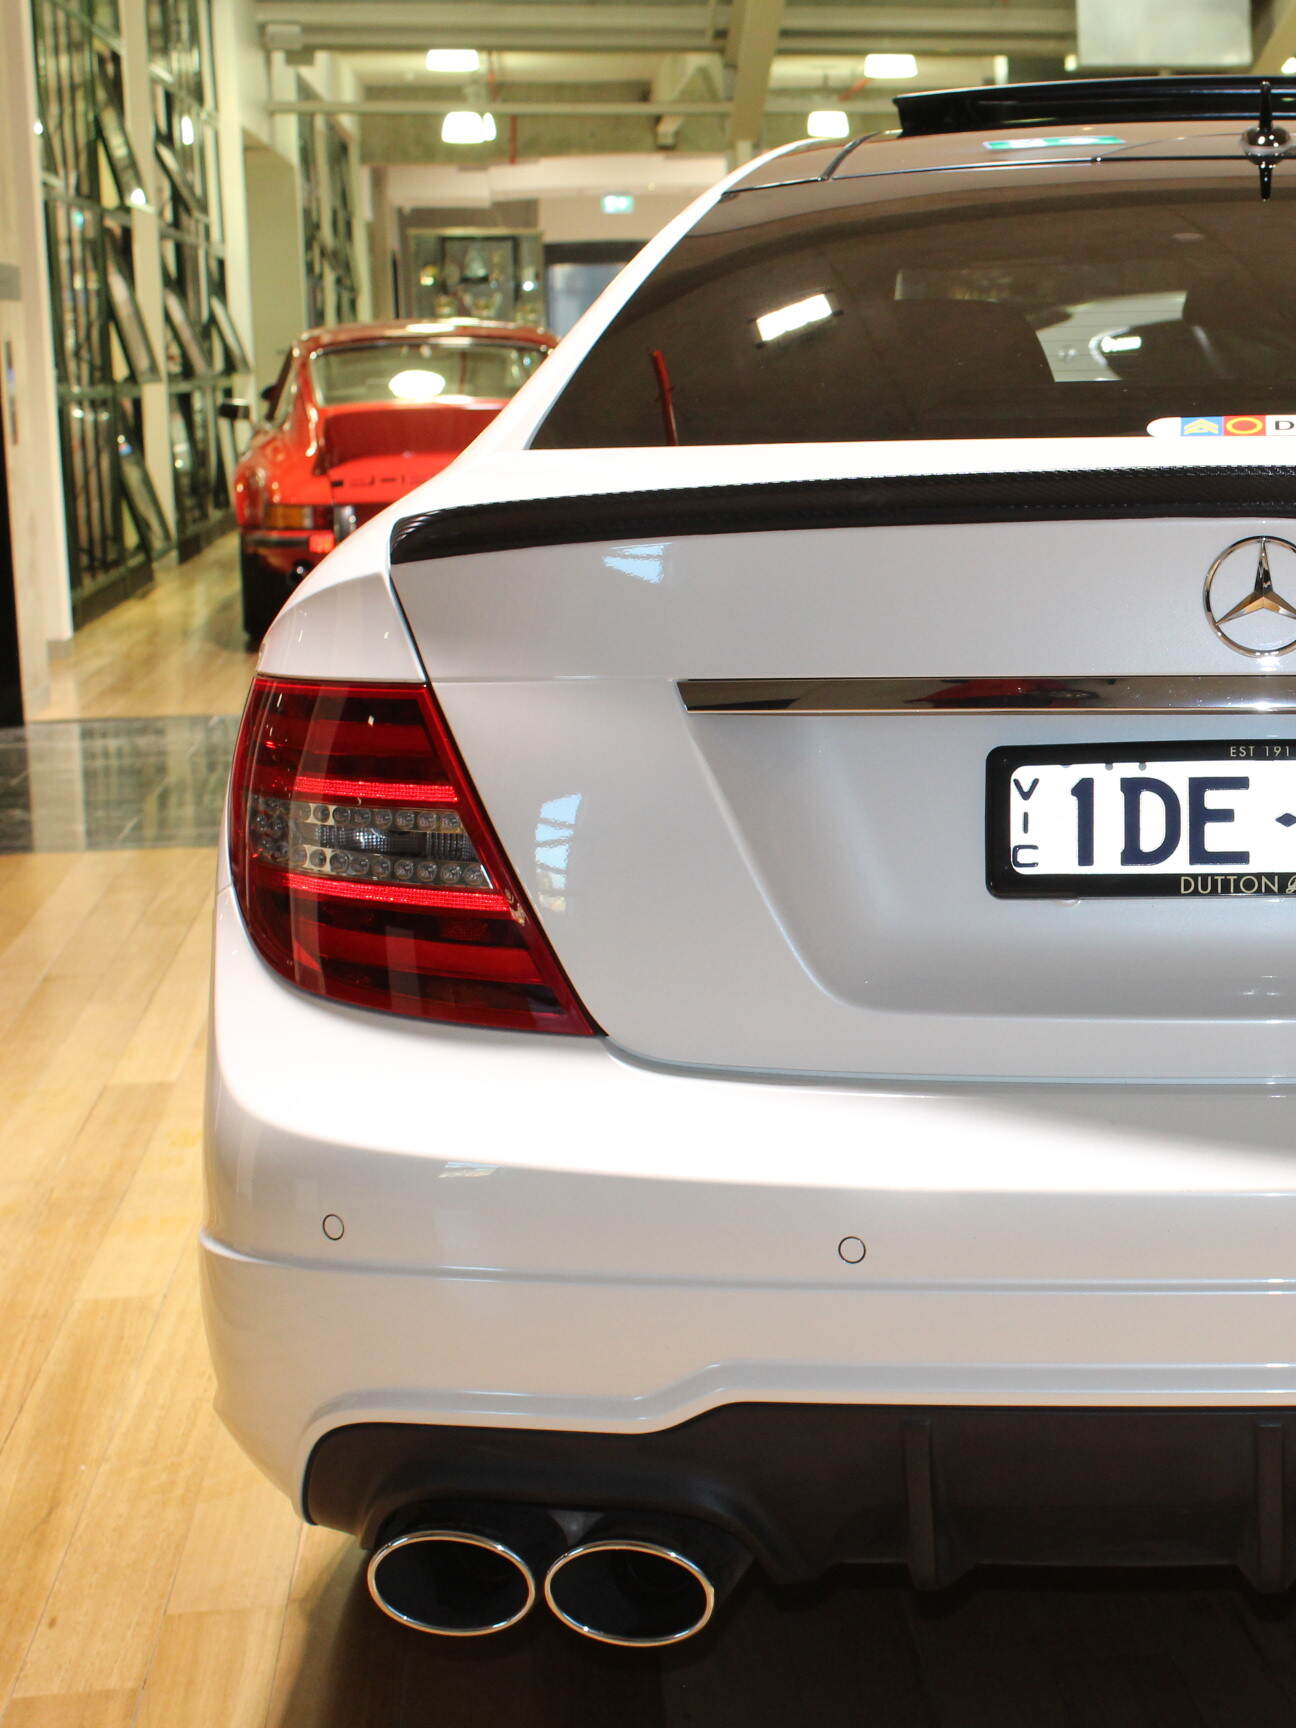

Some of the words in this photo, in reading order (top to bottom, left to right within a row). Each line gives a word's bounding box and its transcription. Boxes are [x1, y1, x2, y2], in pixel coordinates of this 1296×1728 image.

[1230, 745, 1255, 757] EST
[1012, 778, 1040, 868] VIC
[1180, 875, 1279, 894] DUTTON
